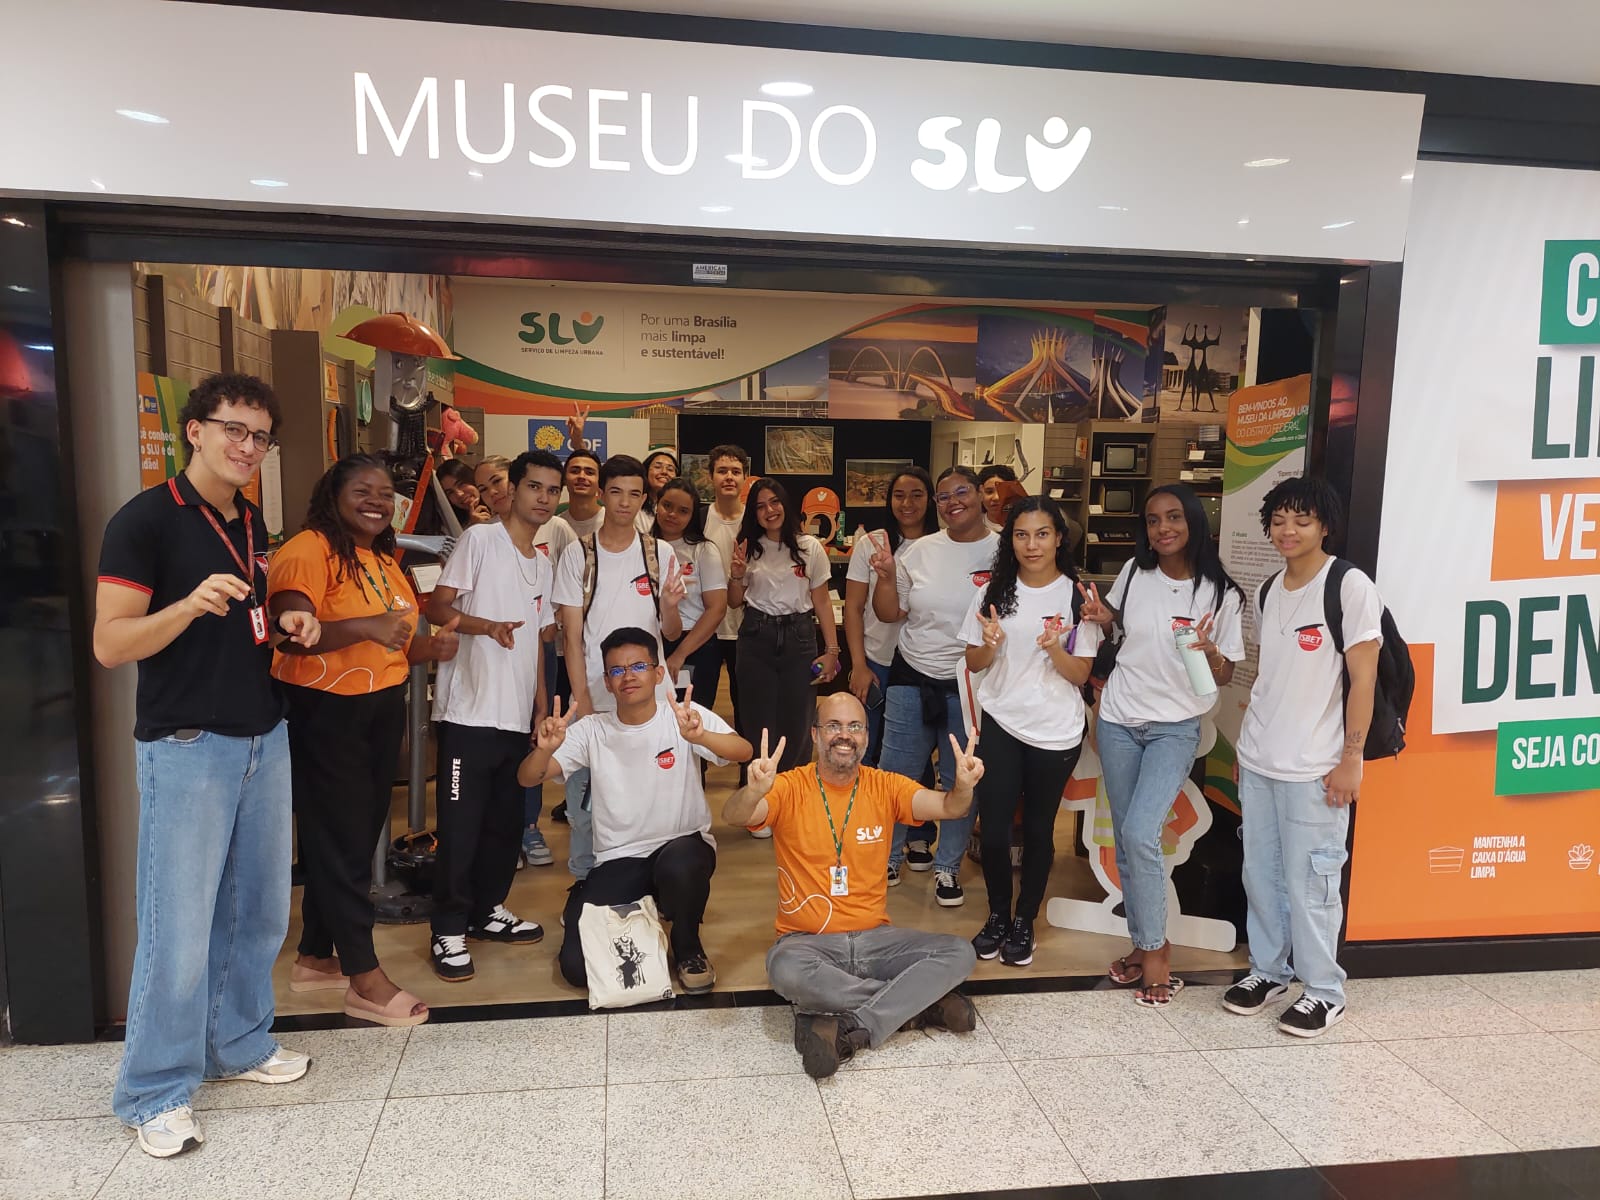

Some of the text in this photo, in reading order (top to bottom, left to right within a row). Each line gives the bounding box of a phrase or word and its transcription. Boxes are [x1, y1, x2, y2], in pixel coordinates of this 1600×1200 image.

[354, 72, 698, 175] MUSEU
[742, 99, 877, 186] DO
[641, 313, 737, 328] Por uma Brasília
[641, 329, 706, 346] mais limpa
[641, 347, 725, 360] e sustentável!
[1531, 355, 1600, 460] LI
[1236, 413, 1259, 425] MUSEU
[1258, 412, 1268, 422] DA
[1269, 407, 1296, 420] LIMPEZA
[1272, 420, 1301, 433] FEDERAL
[148, 430, 177, 442] conhece
[146, 443, 160, 456] SLU
[1512, 735, 1566, 770] SEJA
[451, 758, 461, 801] LACOSTE
[1473, 835, 1526, 849] MANTENHA A
[1472, 849, 1526, 864] CAIXA D'ÁGUA
[1470, 866, 1496, 879] LIMPA
